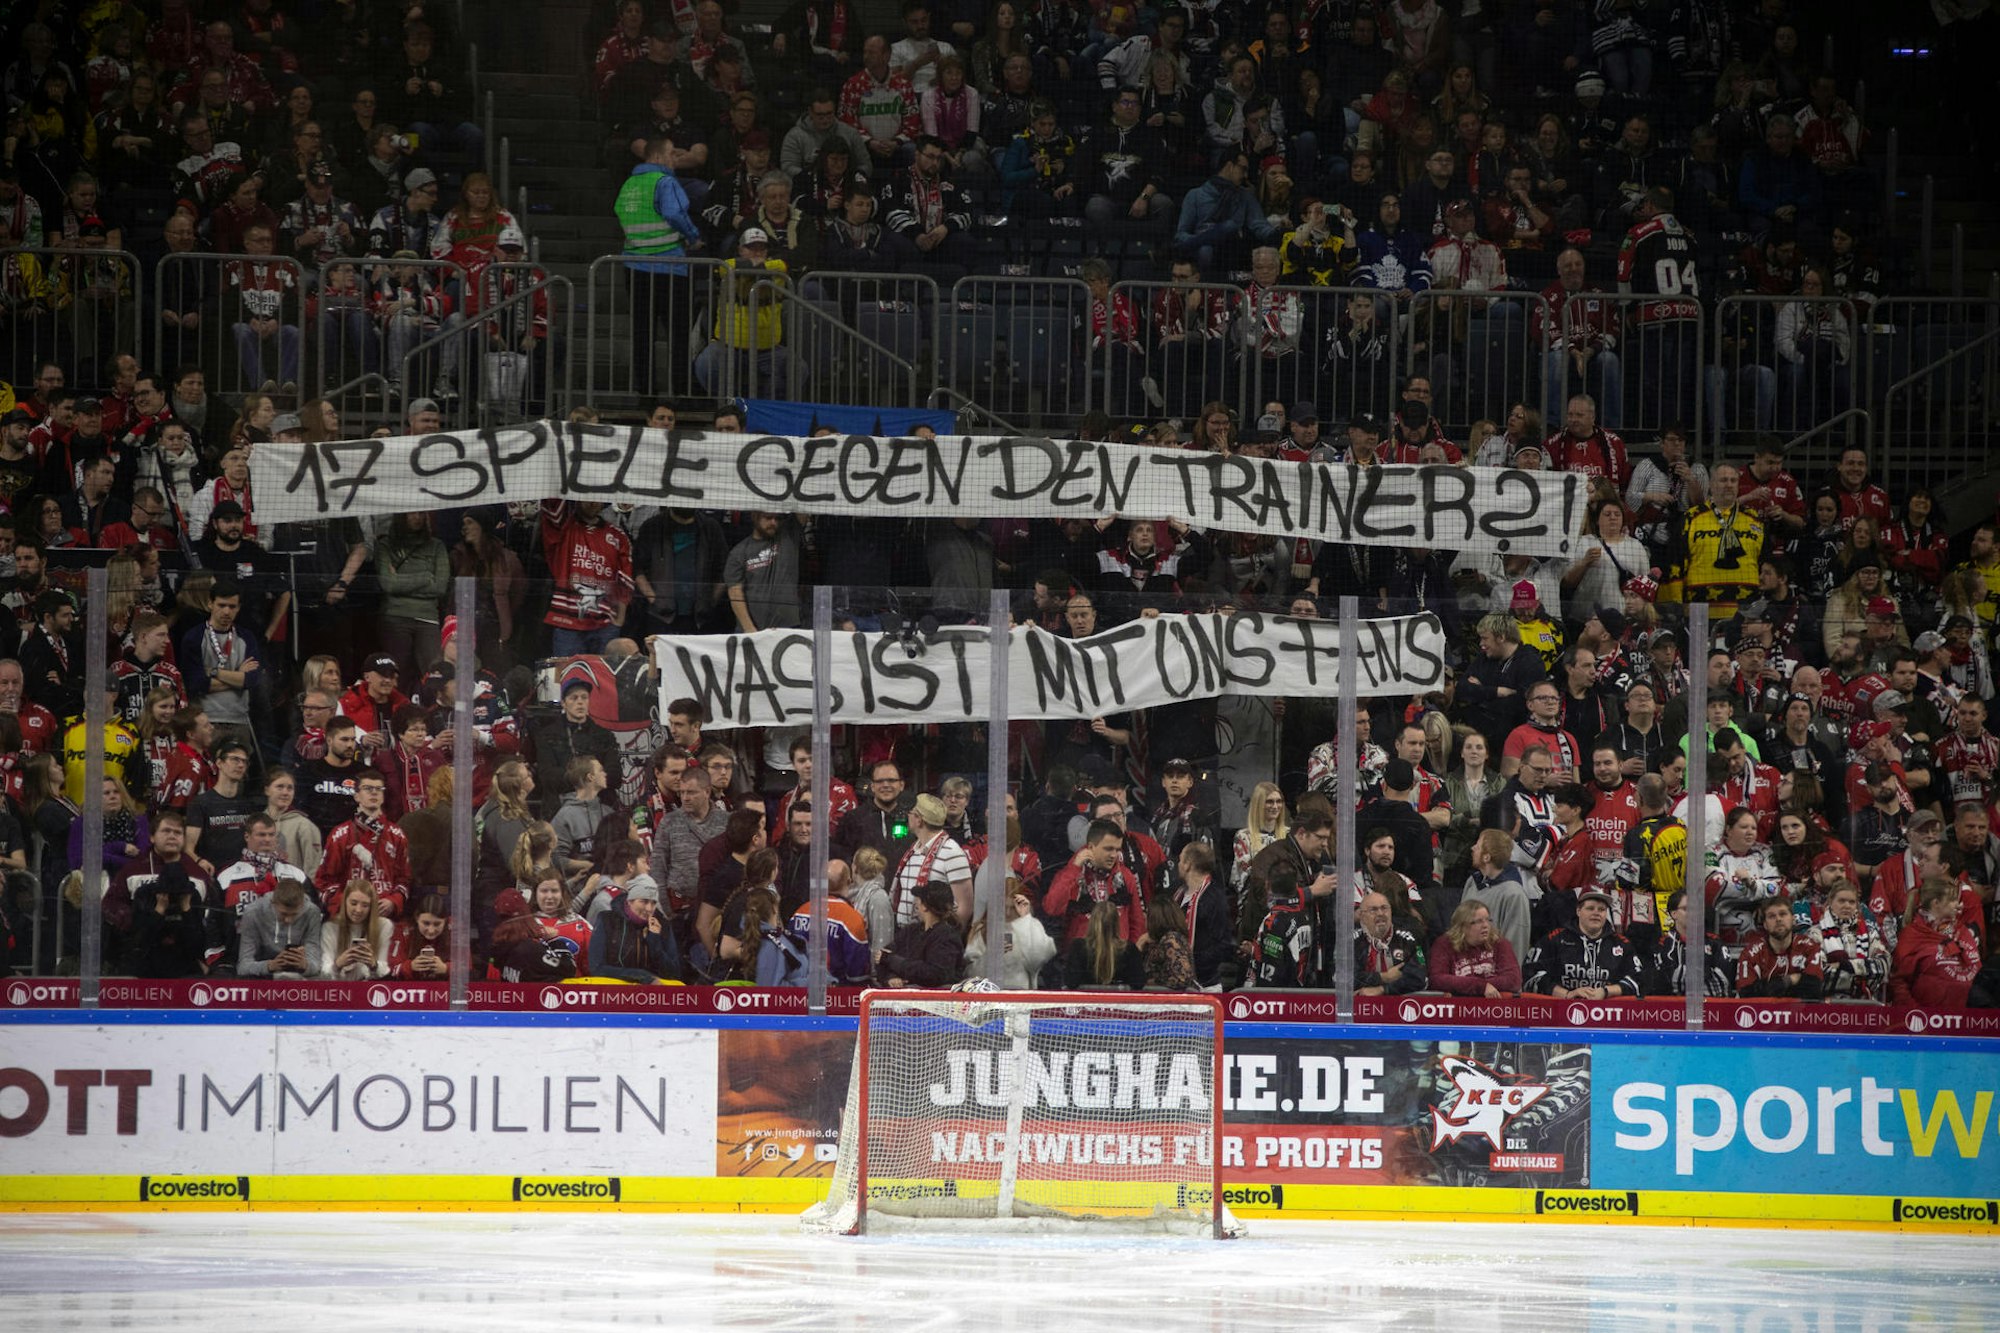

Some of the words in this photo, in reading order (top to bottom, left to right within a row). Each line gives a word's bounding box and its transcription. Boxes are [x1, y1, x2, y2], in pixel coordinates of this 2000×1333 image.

[1654, 257, 1700, 298] 04
[285, 440, 385, 512] 17
[409, 420, 709, 500] SPIELE
[736, 434, 972, 505] GEGEN
[978, 436, 1141, 510] DEN
[1150, 454, 1578, 554] TRAINER?!
[677, 633, 843, 725] WAS
[852, 629, 1014, 716] IST
[1026, 624, 1145, 714] MIT
[1155, 611, 1275, 699] UNS
[173, 778, 193, 796] 29
[1585, 815, 1628, 831] Rhein
[1589, 828, 1628, 845] nerg
[1564, 962, 1610, 981] Rhein
[33, 986, 69, 1001] OTT
[72, 987, 173, 1001] IMOBILIEN
[214, 987, 249, 1002] OTT
[251, 988, 351, 1002] IMMOBILIEN
[392, 989, 427, 1003] OTT
[429, 990, 525, 1004] IMOBILIEN
[564, 990, 599, 1006] OTT
[601, 992, 699, 1007] IMMOBILIEN
[737, 993, 772, 1008] OTT
[1253, 1000, 1287, 1015] OTT
[1421, 1003, 1456, 1019] OTT
[1458, 1005, 1553, 1020] IMMOBILIEN
[1589, 1007, 1624, 1022] OTT
[1758, 1009, 1792, 1026] OTT
[1795, 1011, 1891, 1027] IMMOBILIEN
[1929, 1014, 1964, 1029] OTT
[0, 1067, 153, 1138] OTT
[177, 1073, 667, 1135] IMMOBILIEN
[1467, 1088, 1524, 1106] KEC
[744, 1128, 839, 1140] www.junghaie.de
[1611, 1076, 2000, 1176] sportw
[1505, 1137, 1528, 1150] DIE
[1255, 1136, 1384, 1170] PROFIS
[1493, 1156, 1558, 1169] JUNGHAIE
[149, 1178, 238, 1197] covestro
[521, 1179, 609, 1198] covestro
[1543, 1193, 1628, 1212] covestro
[1902, 1202, 1987, 1222] covestro
